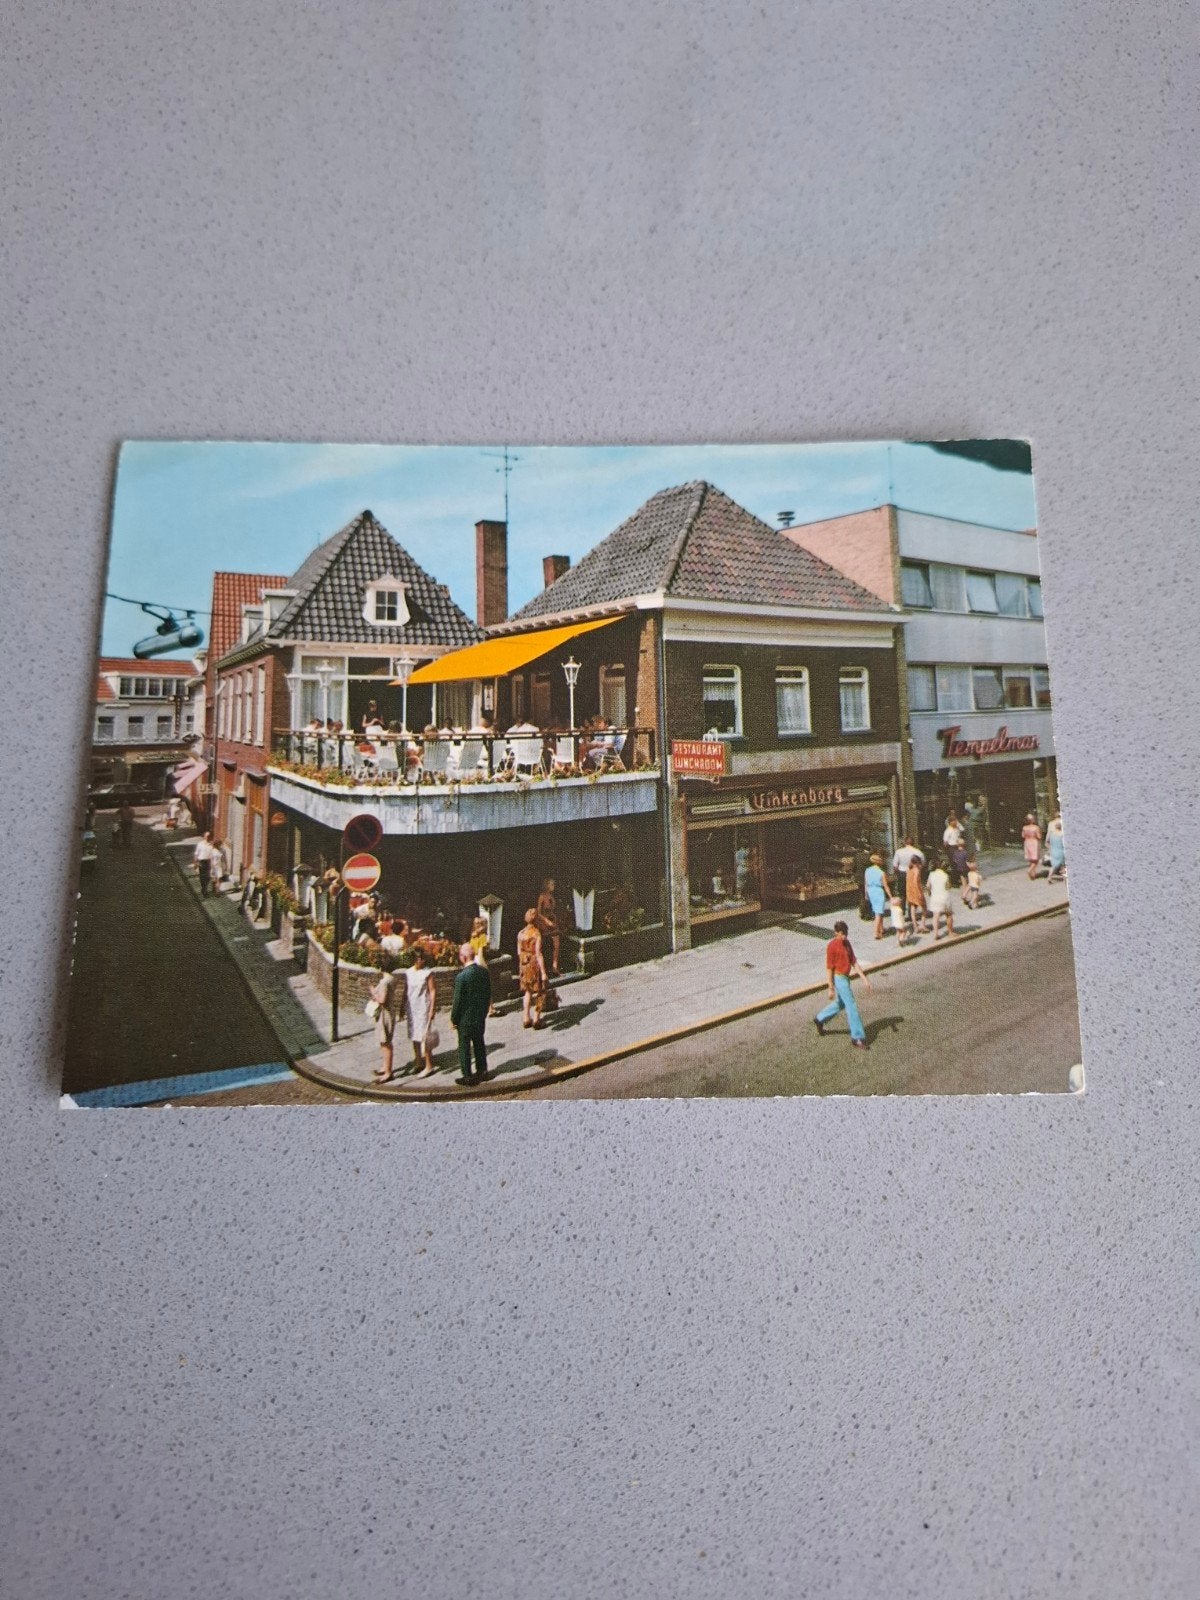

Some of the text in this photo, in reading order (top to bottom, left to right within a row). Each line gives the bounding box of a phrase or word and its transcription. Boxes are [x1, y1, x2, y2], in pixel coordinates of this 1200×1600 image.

[673, 743, 722, 755] RESTAURANT
[937, 725, 1040, 760] Tempelman
[674, 756, 723, 770] LUNCHROOM
